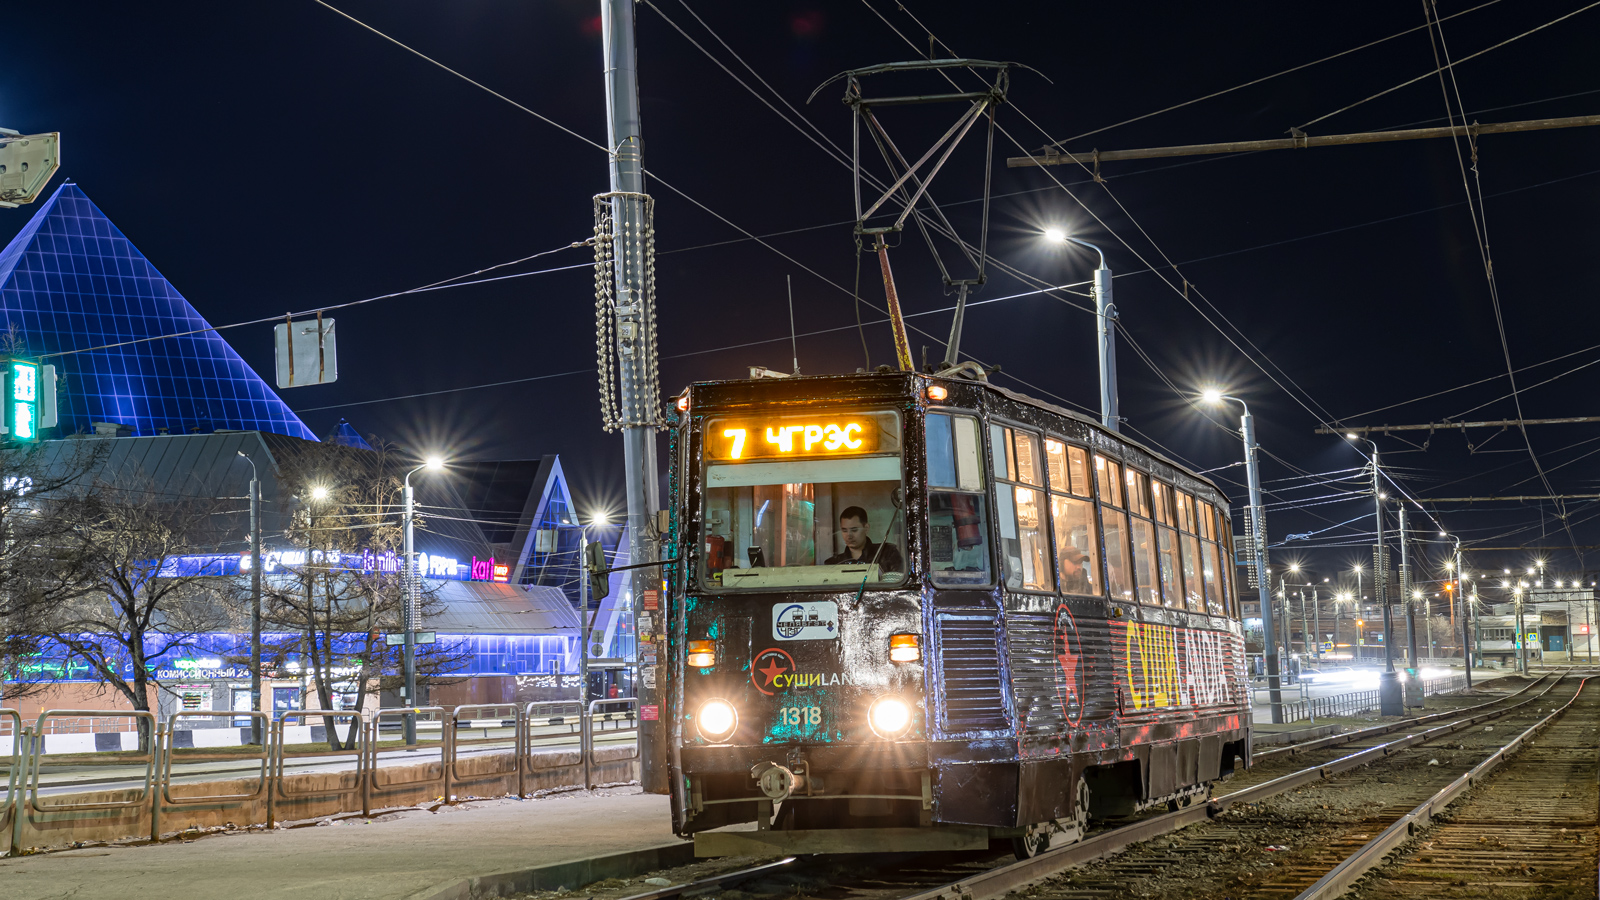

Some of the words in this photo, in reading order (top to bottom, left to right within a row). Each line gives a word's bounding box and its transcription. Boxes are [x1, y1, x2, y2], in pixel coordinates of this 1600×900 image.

[723, 429, 746, 459] 7
[766, 423, 862, 452] ЧГРЭС
[471, 556, 495, 580] kari
[157, 668, 236, 679] КОМИССИОННЫЙ
[236, 669, 250, 678] 24
[773, 672, 865, 688] СУШИLAN
[779, 706, 822, 725] 1318
